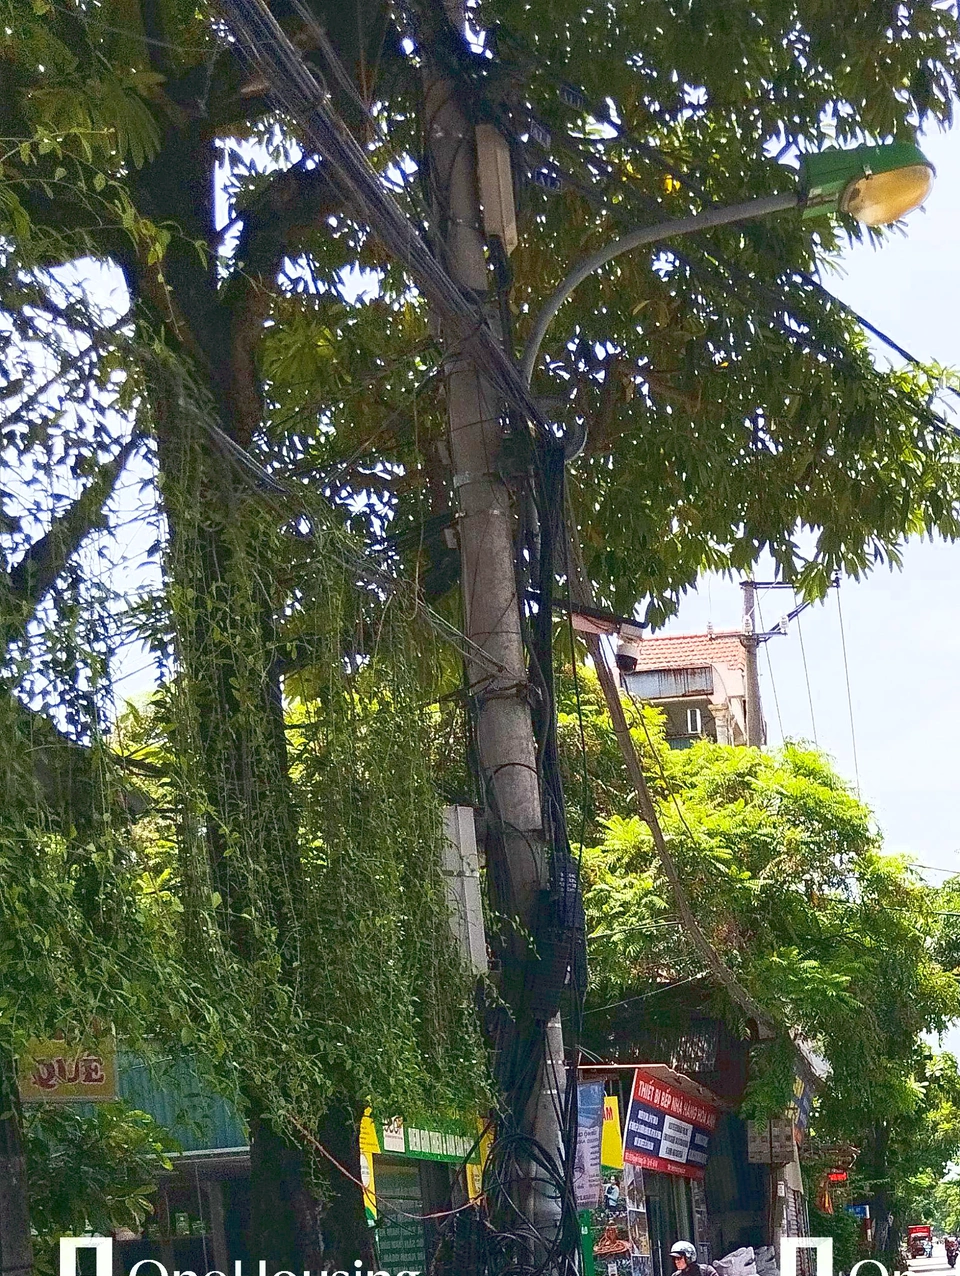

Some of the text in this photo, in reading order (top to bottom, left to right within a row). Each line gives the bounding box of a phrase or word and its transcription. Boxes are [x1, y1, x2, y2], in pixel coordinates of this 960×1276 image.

[638, 1079, 655, 1102] THIẾT
[653, 1088, 662, 1108] BỊ
[660, 1088, 672, 1109] BẾP
[671, 1096, 683, 1116] NHÀ
